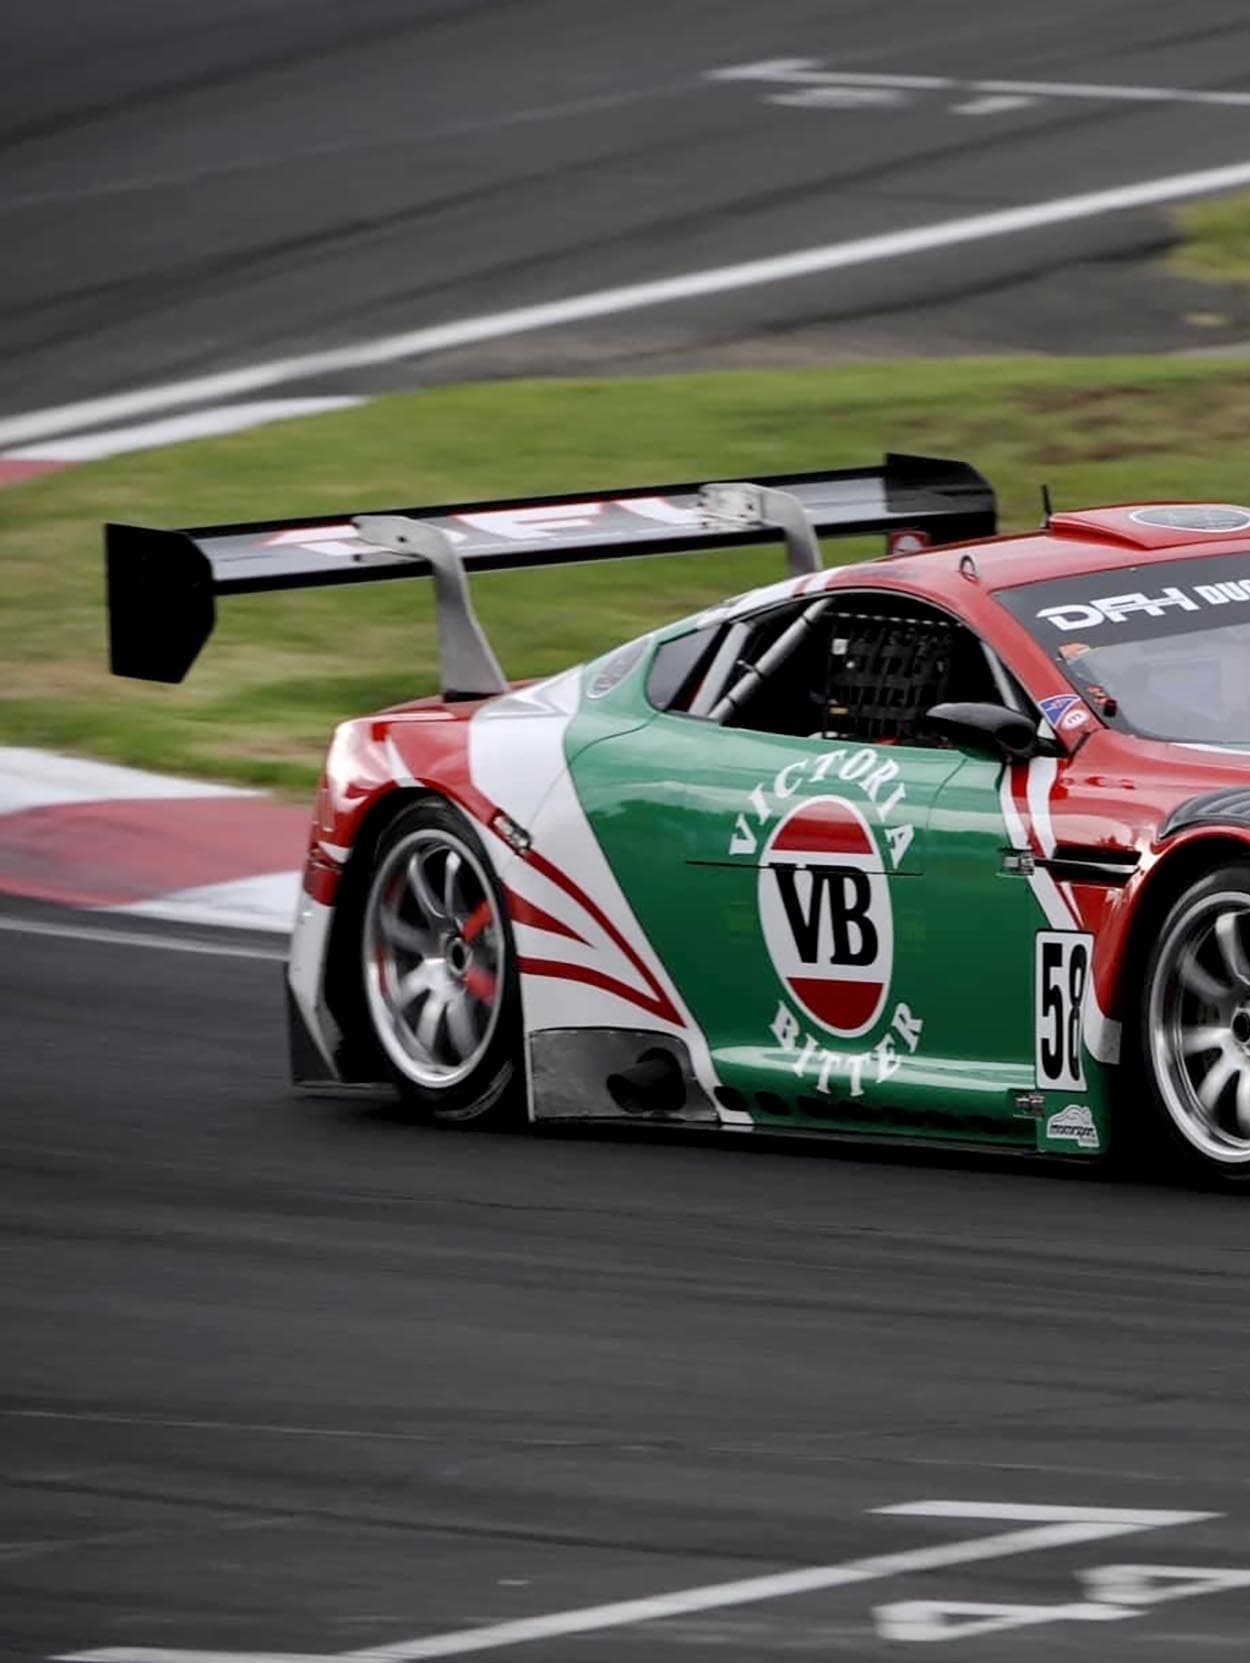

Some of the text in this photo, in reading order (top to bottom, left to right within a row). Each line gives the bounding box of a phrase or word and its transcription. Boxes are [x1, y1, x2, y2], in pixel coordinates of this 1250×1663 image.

[729, 748, 914, 869] VICTORIA
[768, 862, 879, 967] VB
[769, 1000, 924, 1097] BITTER
[1041, 942, 1087, 1081] 58
